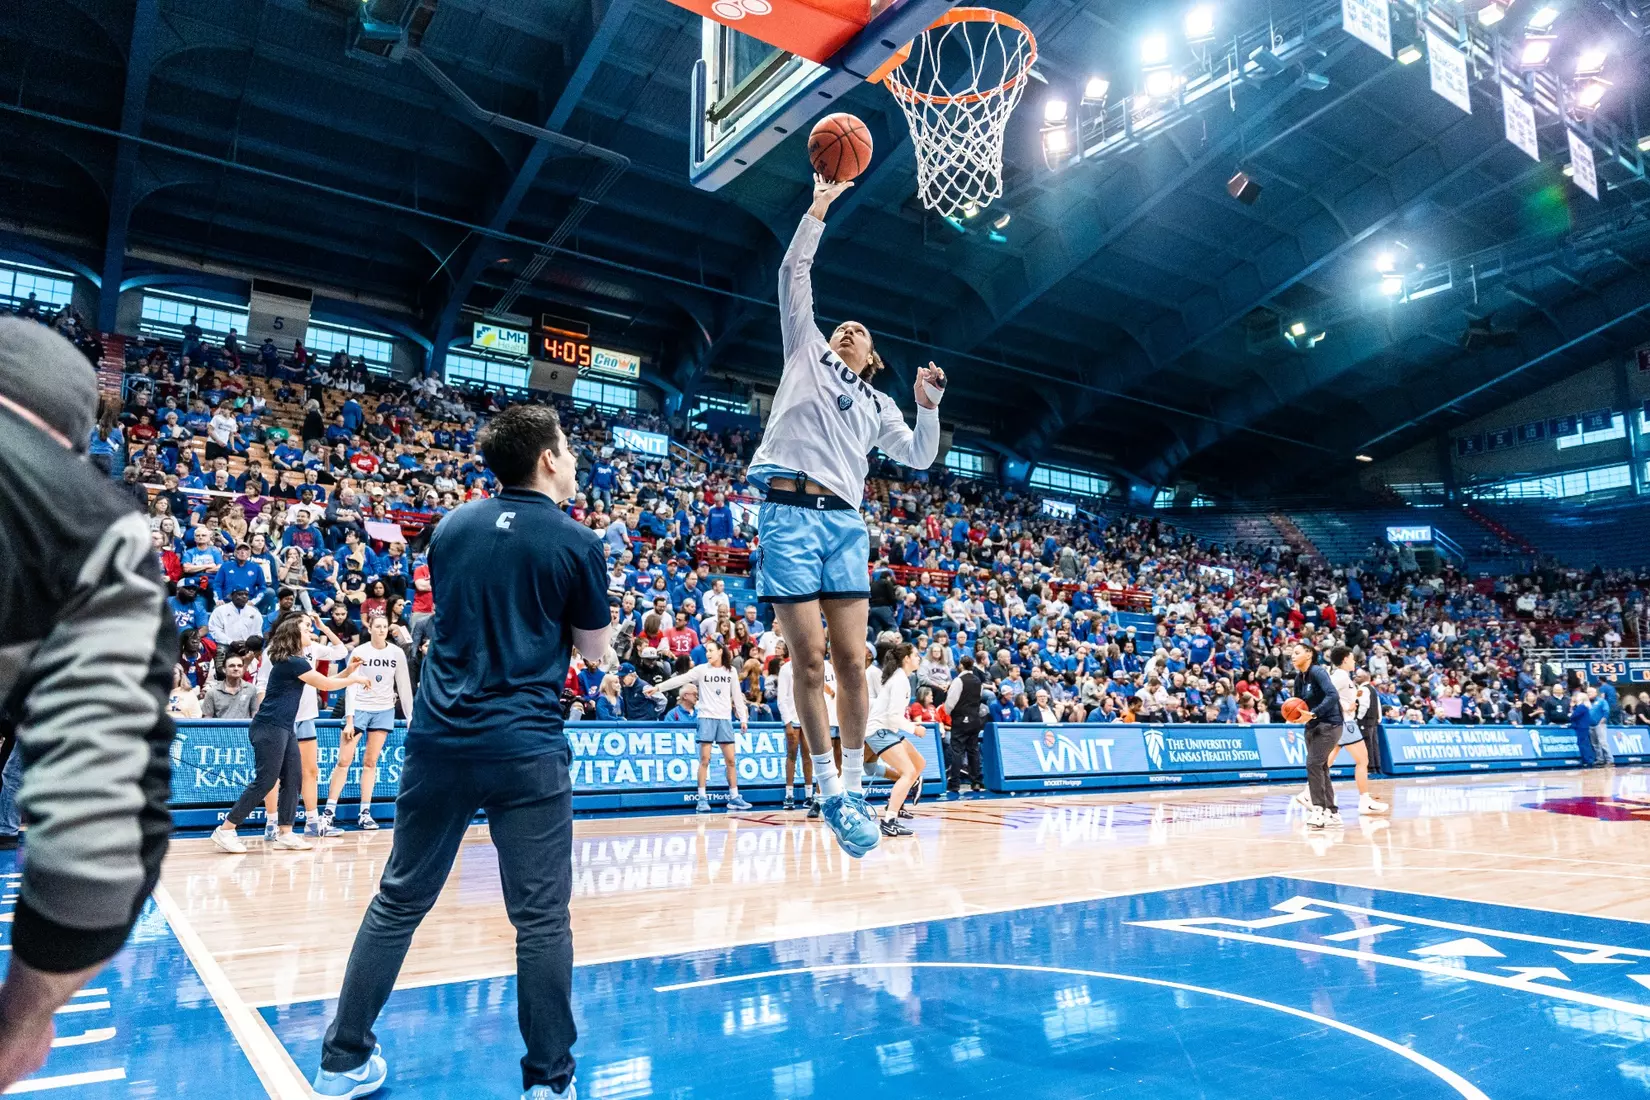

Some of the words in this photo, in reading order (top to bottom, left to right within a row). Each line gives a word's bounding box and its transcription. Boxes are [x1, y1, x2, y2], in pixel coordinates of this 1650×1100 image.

[273, 316, 284, 330] 5
[498, 329, 527, 345] LMH
[497, 341, 527, 352] Health
[544, 337, 590, 366] 4:05
[550, 370, 558, 380] 6
[816, 496, 825, 509] C
[495, 511, 516, 529] C
[1389, 528, 1428, 541] WNIT
[675, 640, 691, 652] 13
[361, 658, 397, 668] LIONS
[704, 674, 732, 684] LIONS
[1412, 730, 1462, 744] WOMEN'S
[1461, 730, 1510, 743] NATIONAL
[1166, 738, 1185, 750] THE
[1185, 738, 1232, 750] UNIVERSITY
[1232, 738, 1243, 749] OF
[194, 745, 248, 765] THE
[1032, 733, 1115, 773] WNIT
[1169, 751, 1201, 763] KANSAS
[1201, 750, 1232, 762] HEALTH
[1232, 749, 1260, 761] SYSTEM
[1402, 744, 1462, 760] INVITATION
[1461, 744, 1524, 758] TOURNAMENT
[532, 1089, 549, 1098] NIKE
